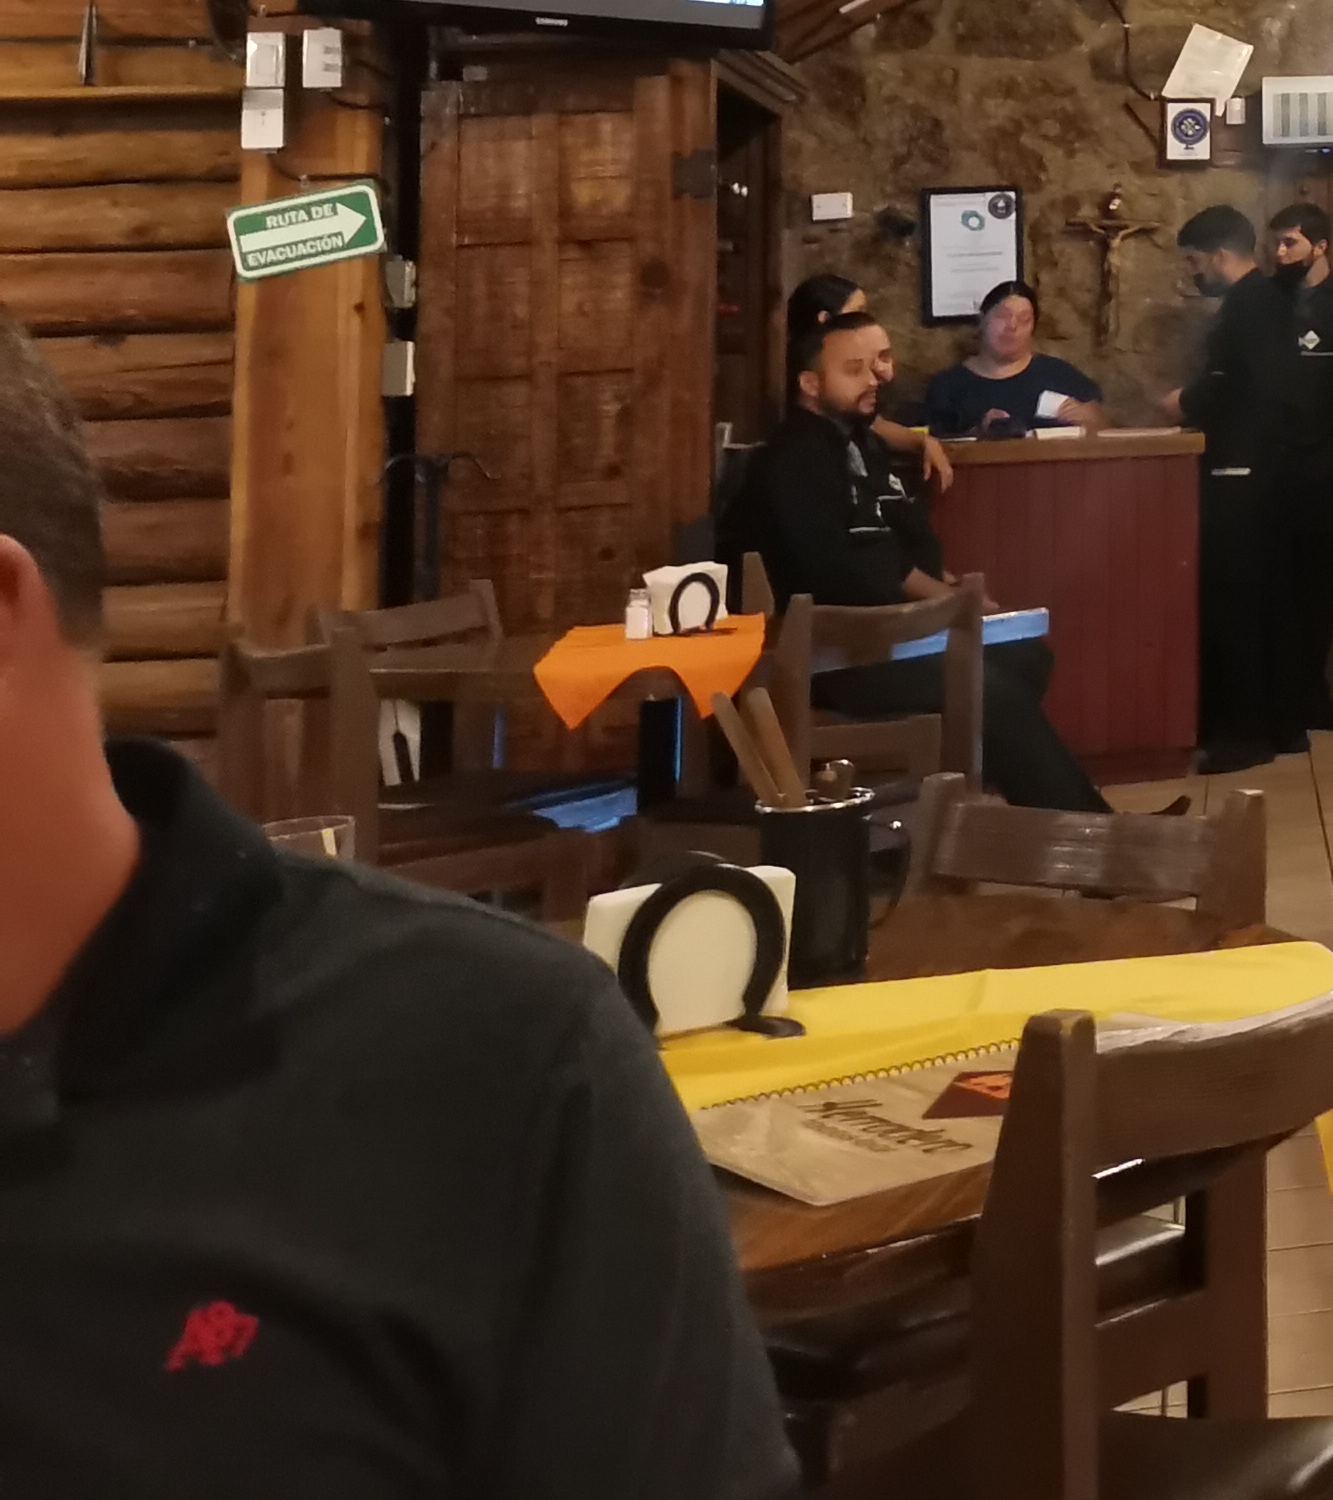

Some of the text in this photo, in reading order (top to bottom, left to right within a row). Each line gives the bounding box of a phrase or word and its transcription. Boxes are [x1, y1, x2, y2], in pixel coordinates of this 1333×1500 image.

[266, 204, 333, 228] RUTA DE
[247, 235, 343, 266] EVACUACIÓN
